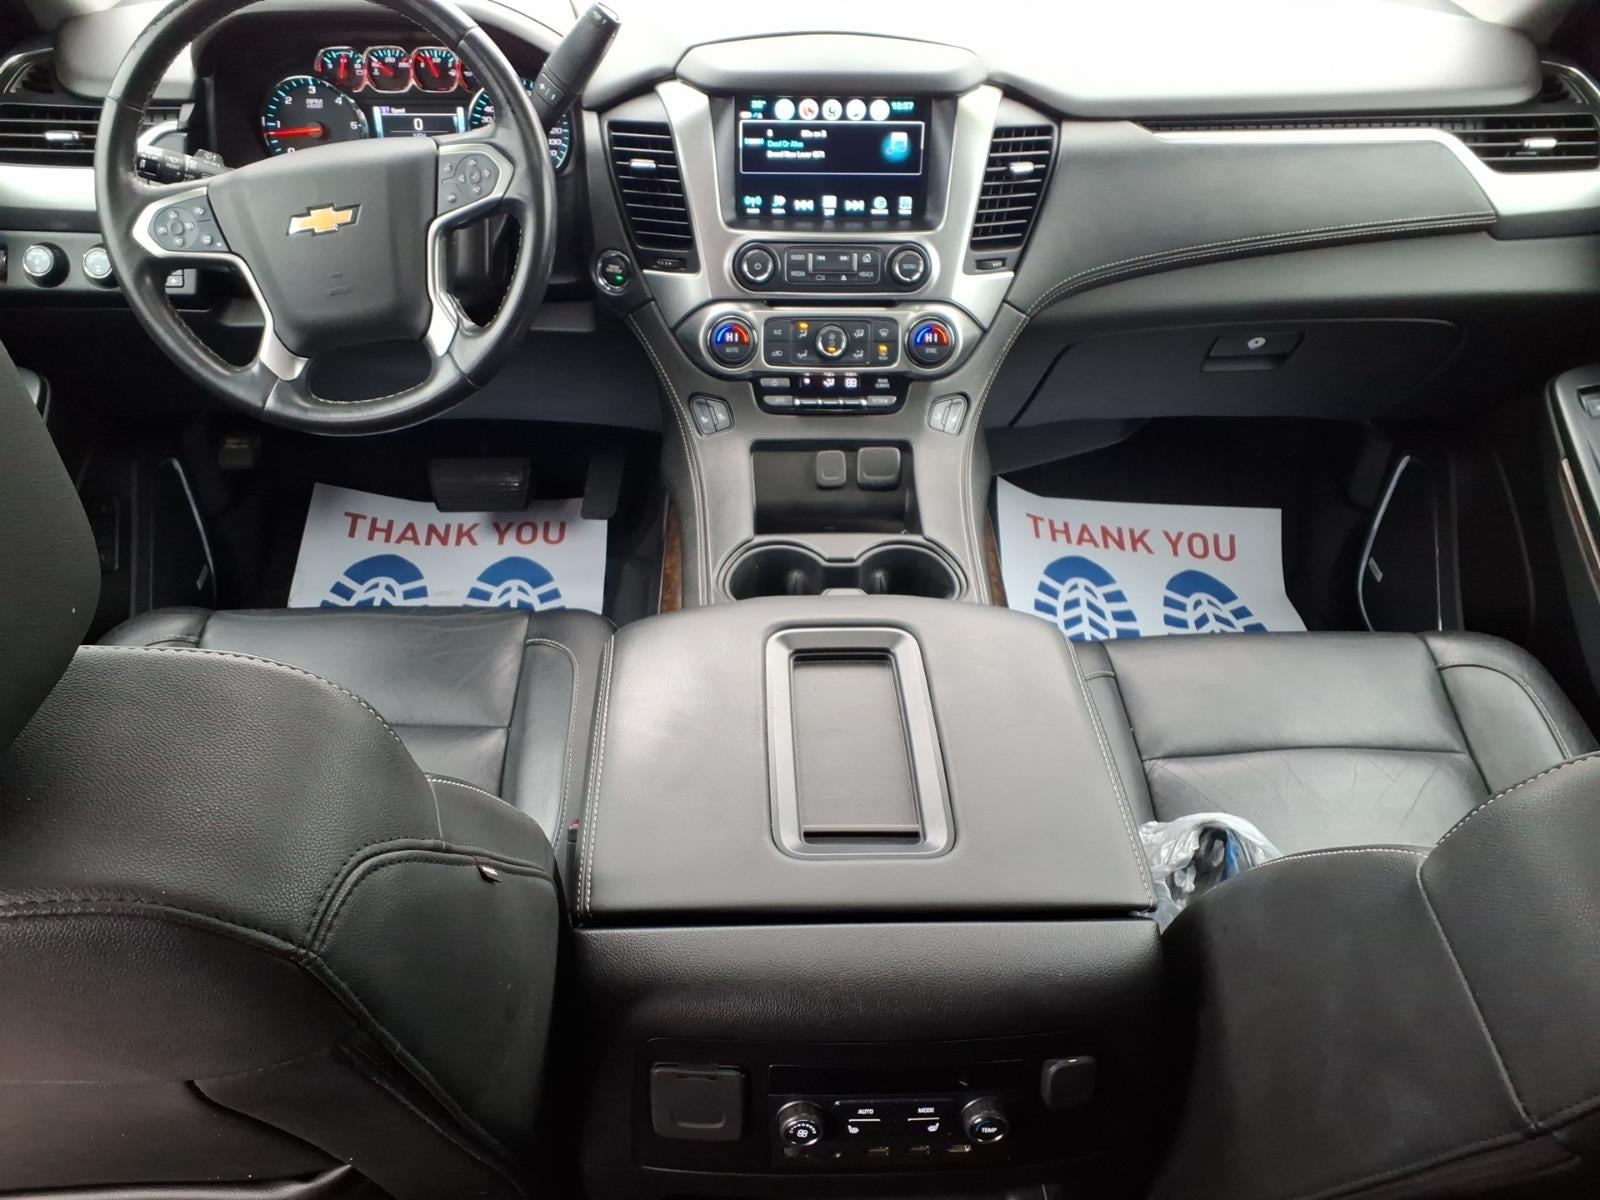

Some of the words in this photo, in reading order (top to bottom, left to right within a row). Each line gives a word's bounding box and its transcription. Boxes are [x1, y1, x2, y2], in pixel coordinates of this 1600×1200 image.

[308, 86, 316, 94] 3
[284, 96, 293, 105] 2
[334, 97, 343, 105] 4
[276, 120, 281, 128] 1
[413, 118, 424, 131] 0
[725, 332, 739, 342] HI
[924, 333, 938, 343] HI
[343, 511, 481, 546] THANK
[492, 520, 567, 546] YOU
[1025, 512, 1155, 555] THANK
[1161, 530, 1237, 562] YOU
